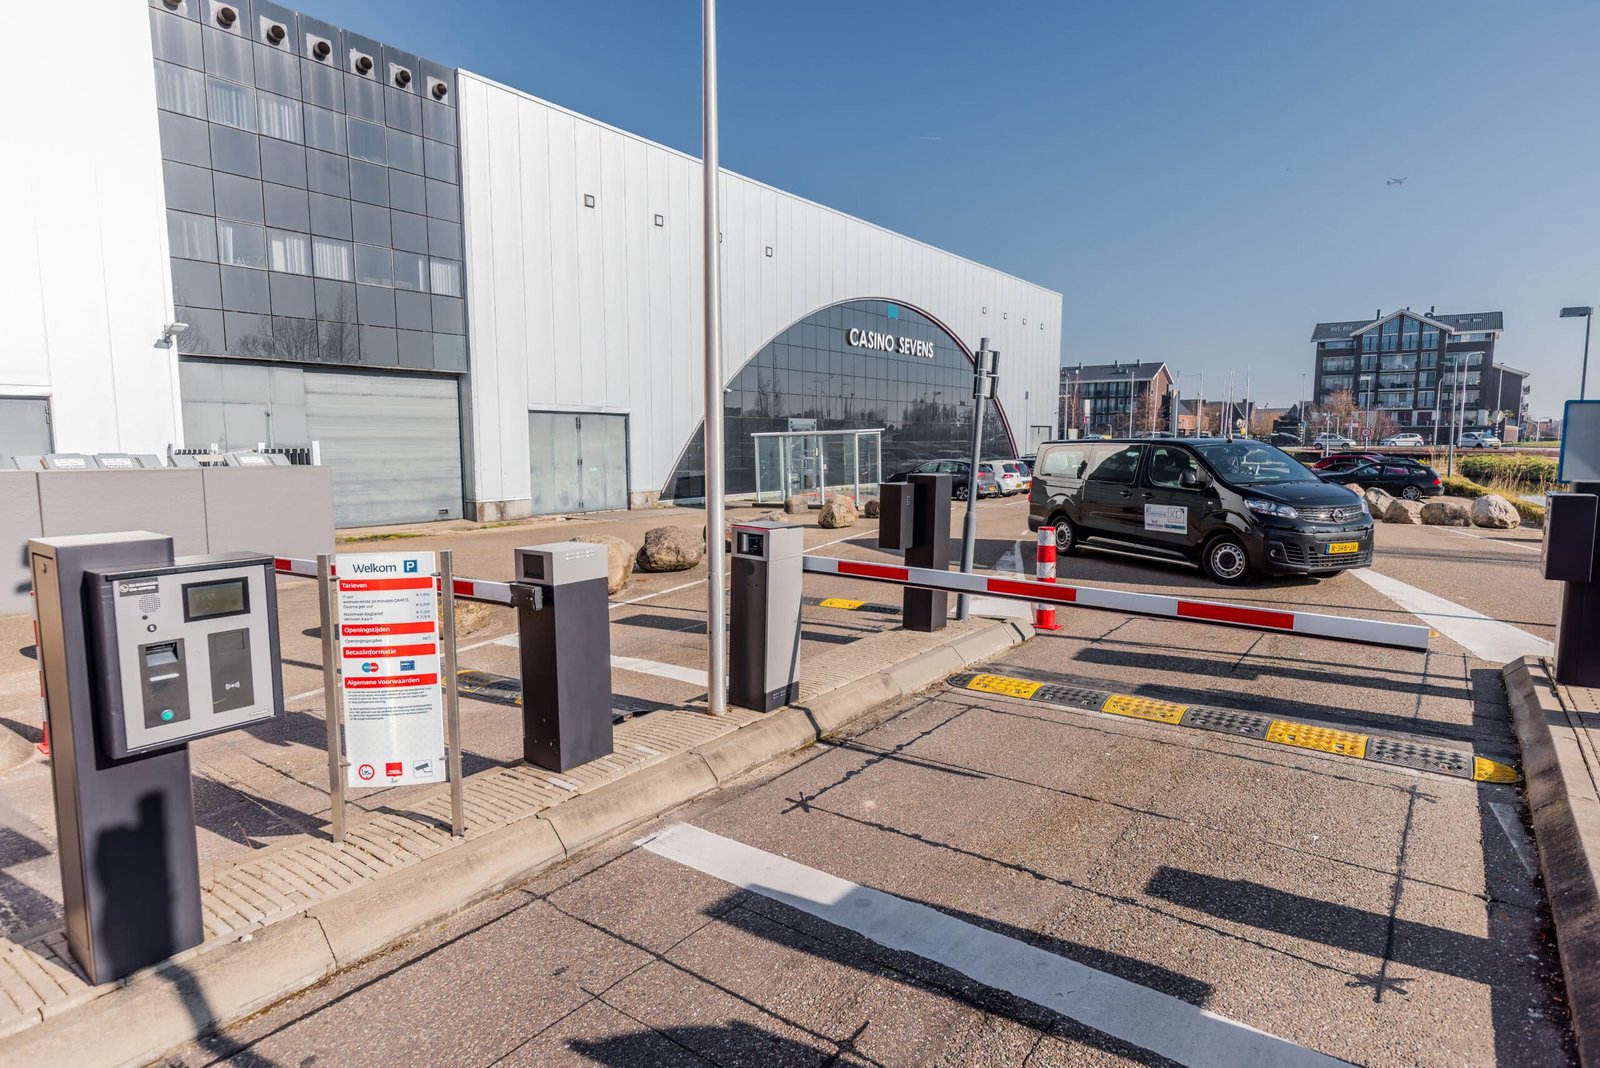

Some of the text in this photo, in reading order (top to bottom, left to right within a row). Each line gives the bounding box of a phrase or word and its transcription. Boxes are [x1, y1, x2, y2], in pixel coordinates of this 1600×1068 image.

[849, 328, 934, 358] CASINO SEVENS
[353, 562, 414, 573] Welkom P
